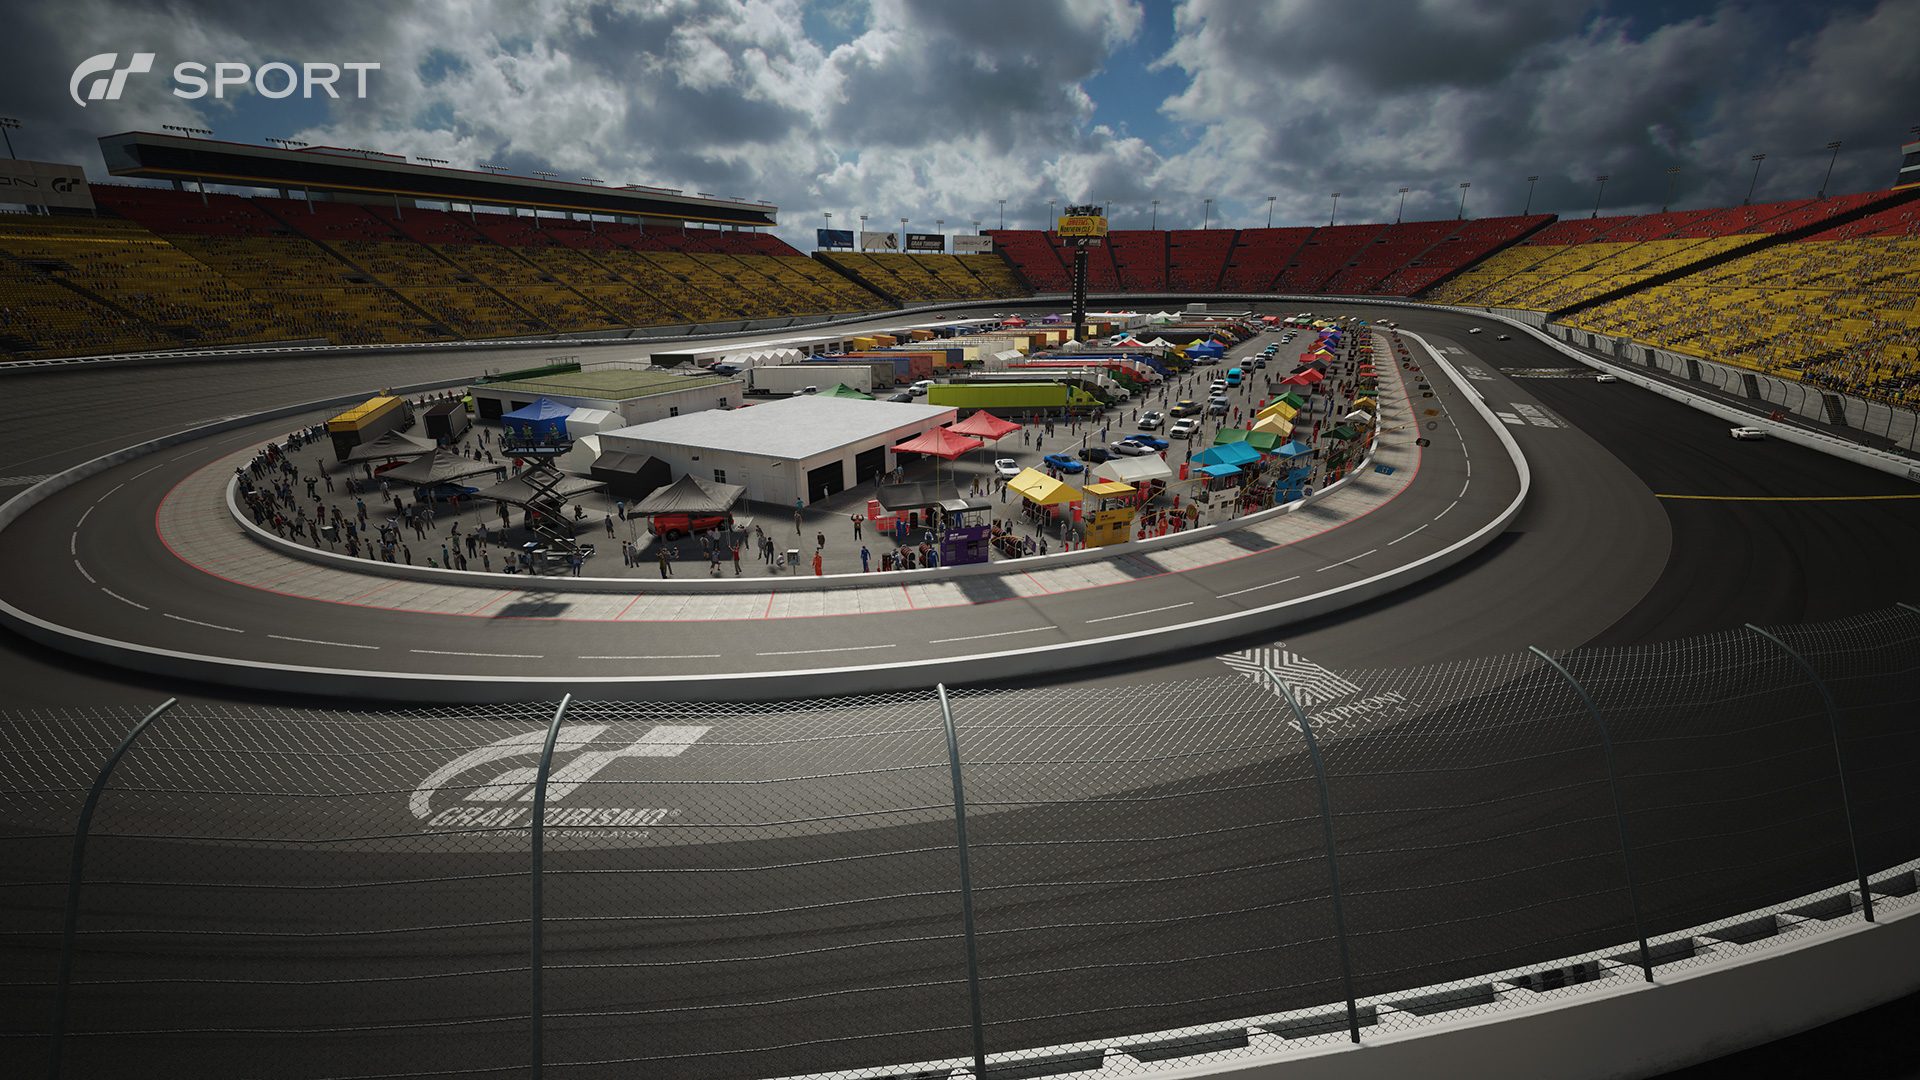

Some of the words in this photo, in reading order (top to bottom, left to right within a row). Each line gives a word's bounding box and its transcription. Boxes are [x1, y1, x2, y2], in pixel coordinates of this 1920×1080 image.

[428, 807, 529, 827] GRAN
[494, 829, 557, 838] DRIVG
[561, 830, 649, 838] SIMULATOR
